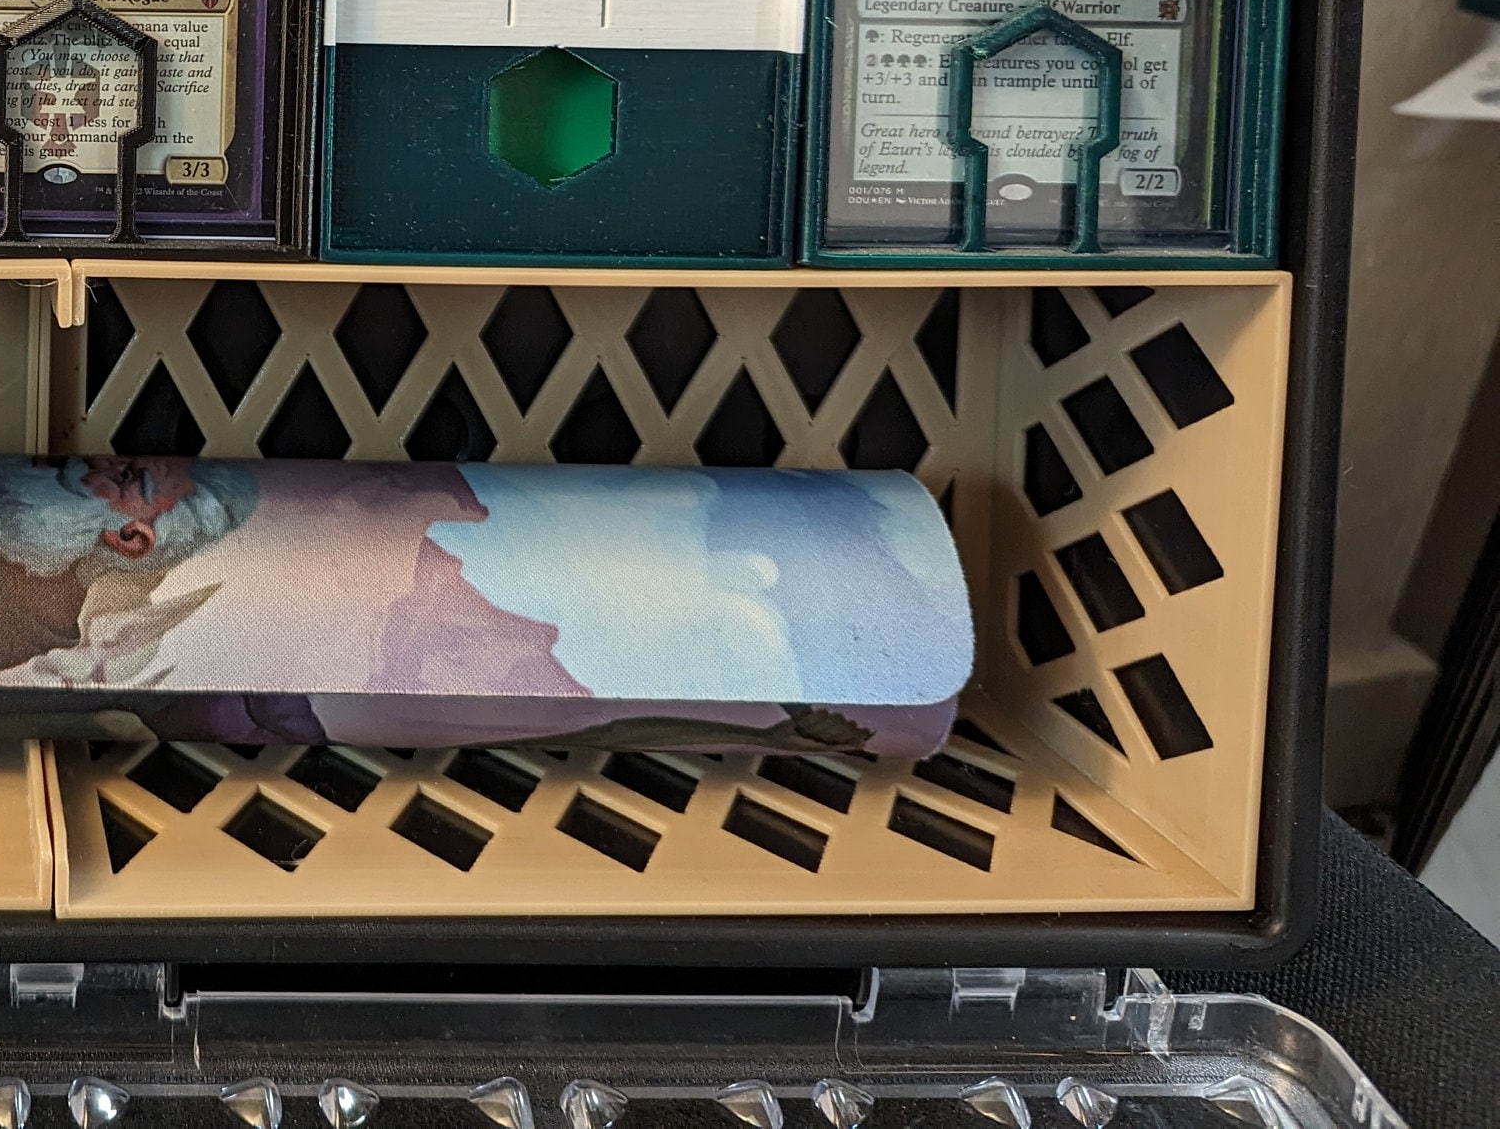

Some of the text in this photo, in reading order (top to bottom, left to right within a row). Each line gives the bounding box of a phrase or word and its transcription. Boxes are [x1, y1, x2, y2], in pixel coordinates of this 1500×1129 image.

[948, 0, 1014, 13] Creature
[1062, 0, 1121, 15] Warrior
[173, 21, 209, 33] value
[82, 34, 113, 48] blitz
[163, 36, 200, 50] equal
[1106, 32, 1134, 47] Elf.
[21, 48, 55, 63] (You
[90, 50, 131, 63] choose
[178, 50, 205, 63] that
[34, 79, 62, 93] dies,
[65, 79, 98, 92] draw
[156, 80, 210, 94] Sacrifice
[862, 72, 1099, 92] +3/+3 trample until
[60, 96, 89, 108] next
[862, 91, 901, 104] turn.
[33, 116, 61, 128] cost
[83, 116, 108, 129] less
[861, 122, 1158, 144] Great hero betrayer? truth
[39, 144, 79, 160] game.
[1005, 143, 1062, 159] clouded
[182, 161, 210, 178] 3/3
[858, 160, 909, 177] legend.
[1135, 174, 1165, 190] 2/2
